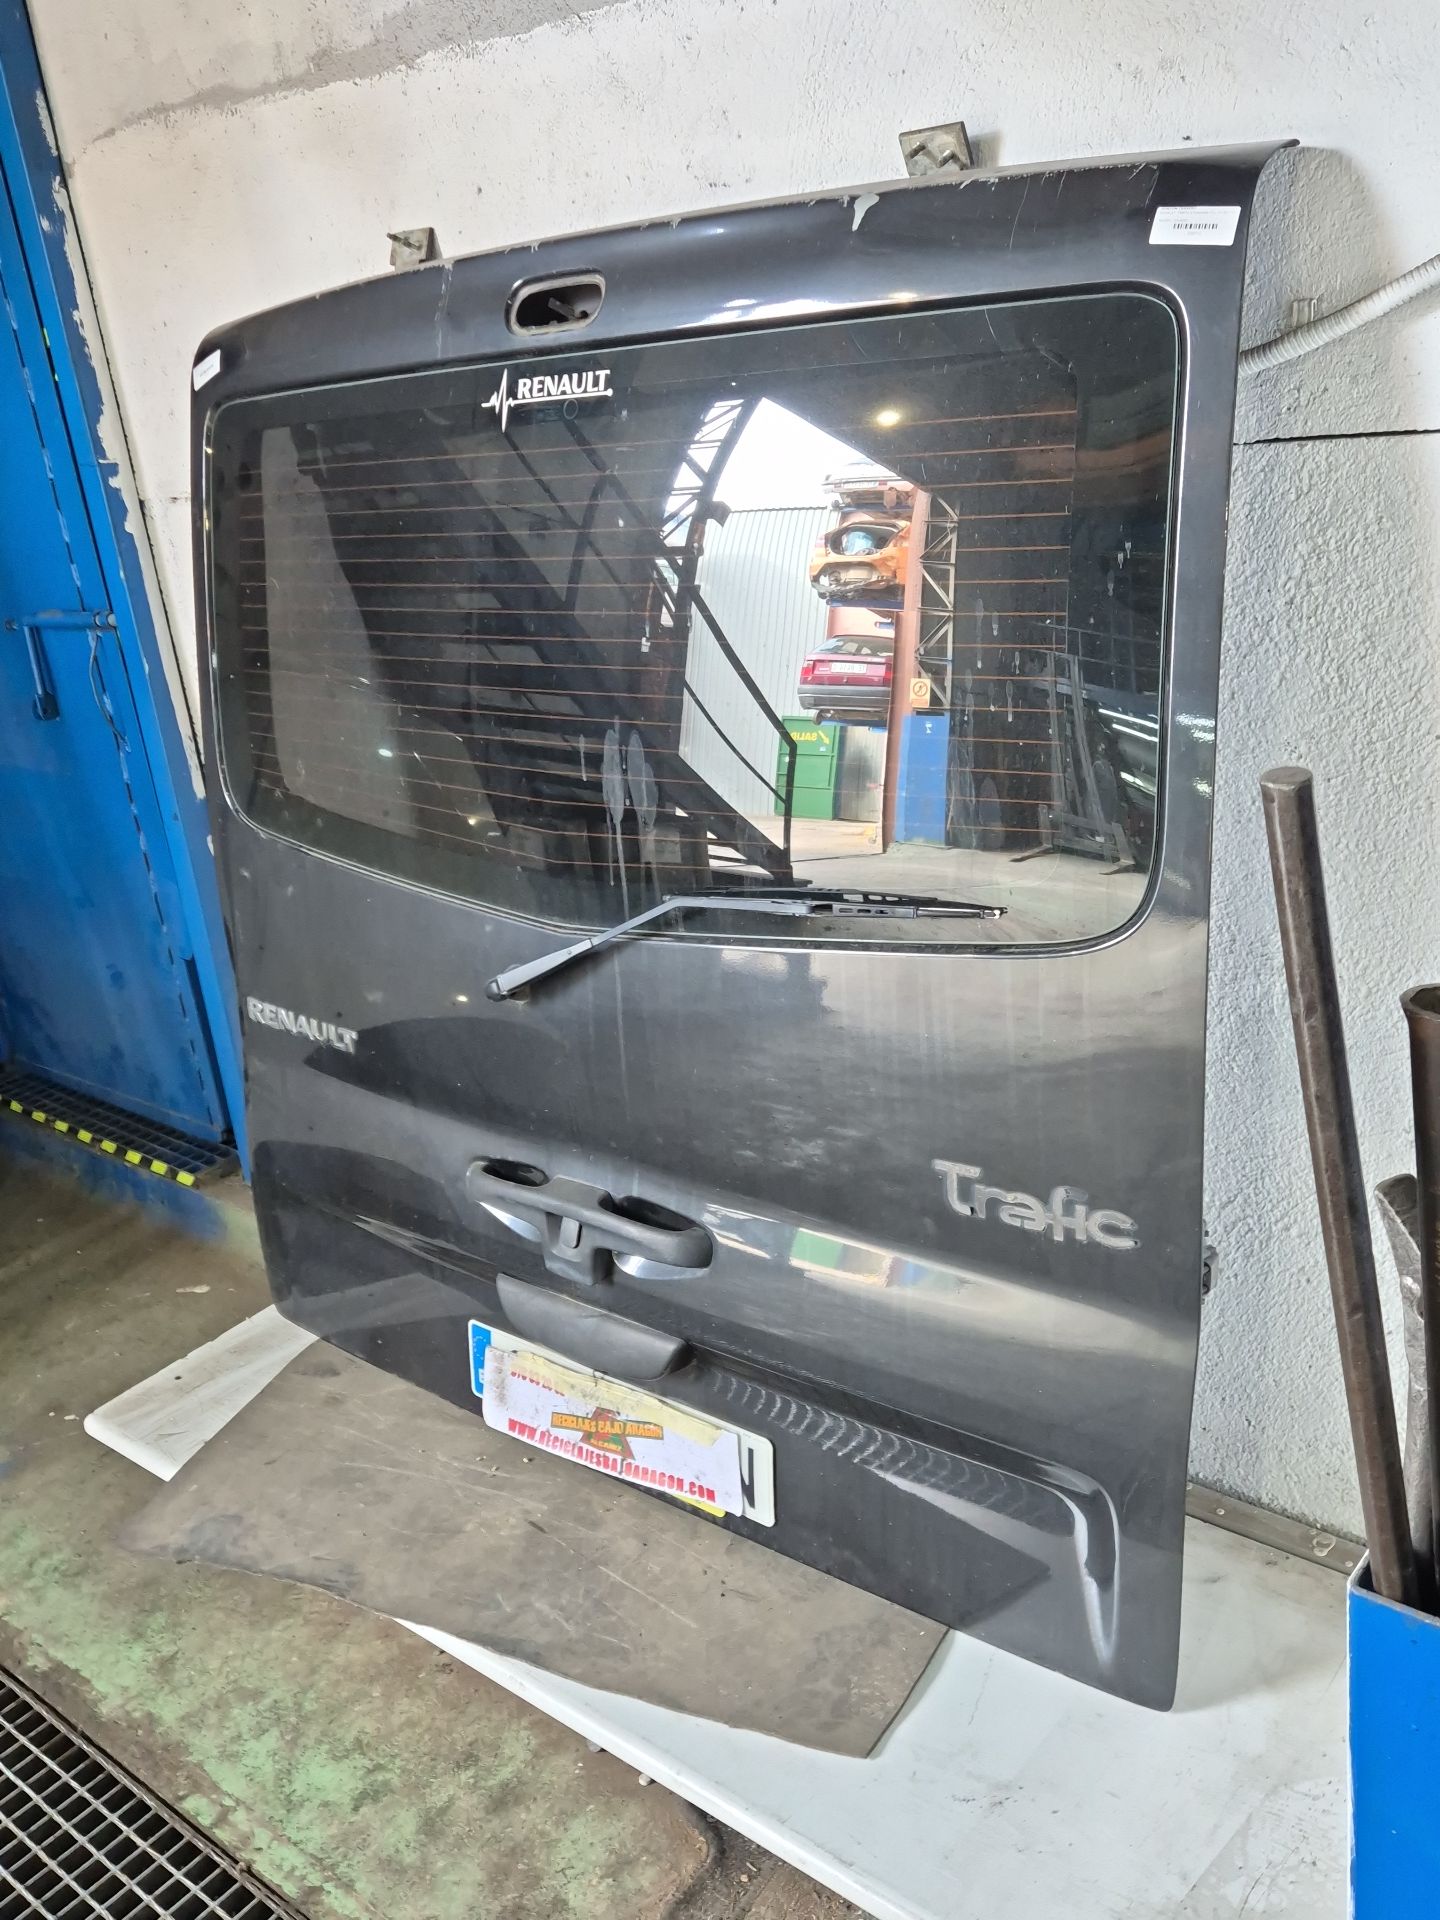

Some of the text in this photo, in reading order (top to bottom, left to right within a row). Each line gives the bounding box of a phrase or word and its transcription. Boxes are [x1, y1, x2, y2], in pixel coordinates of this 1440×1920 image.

[517, 370, 611, 399] RENAULT
[247, 996, 358, 1054] RENAULT
[931, 1158, 1141, 1249] Trafic
[598, 1420, 623, 1435] BAJO
